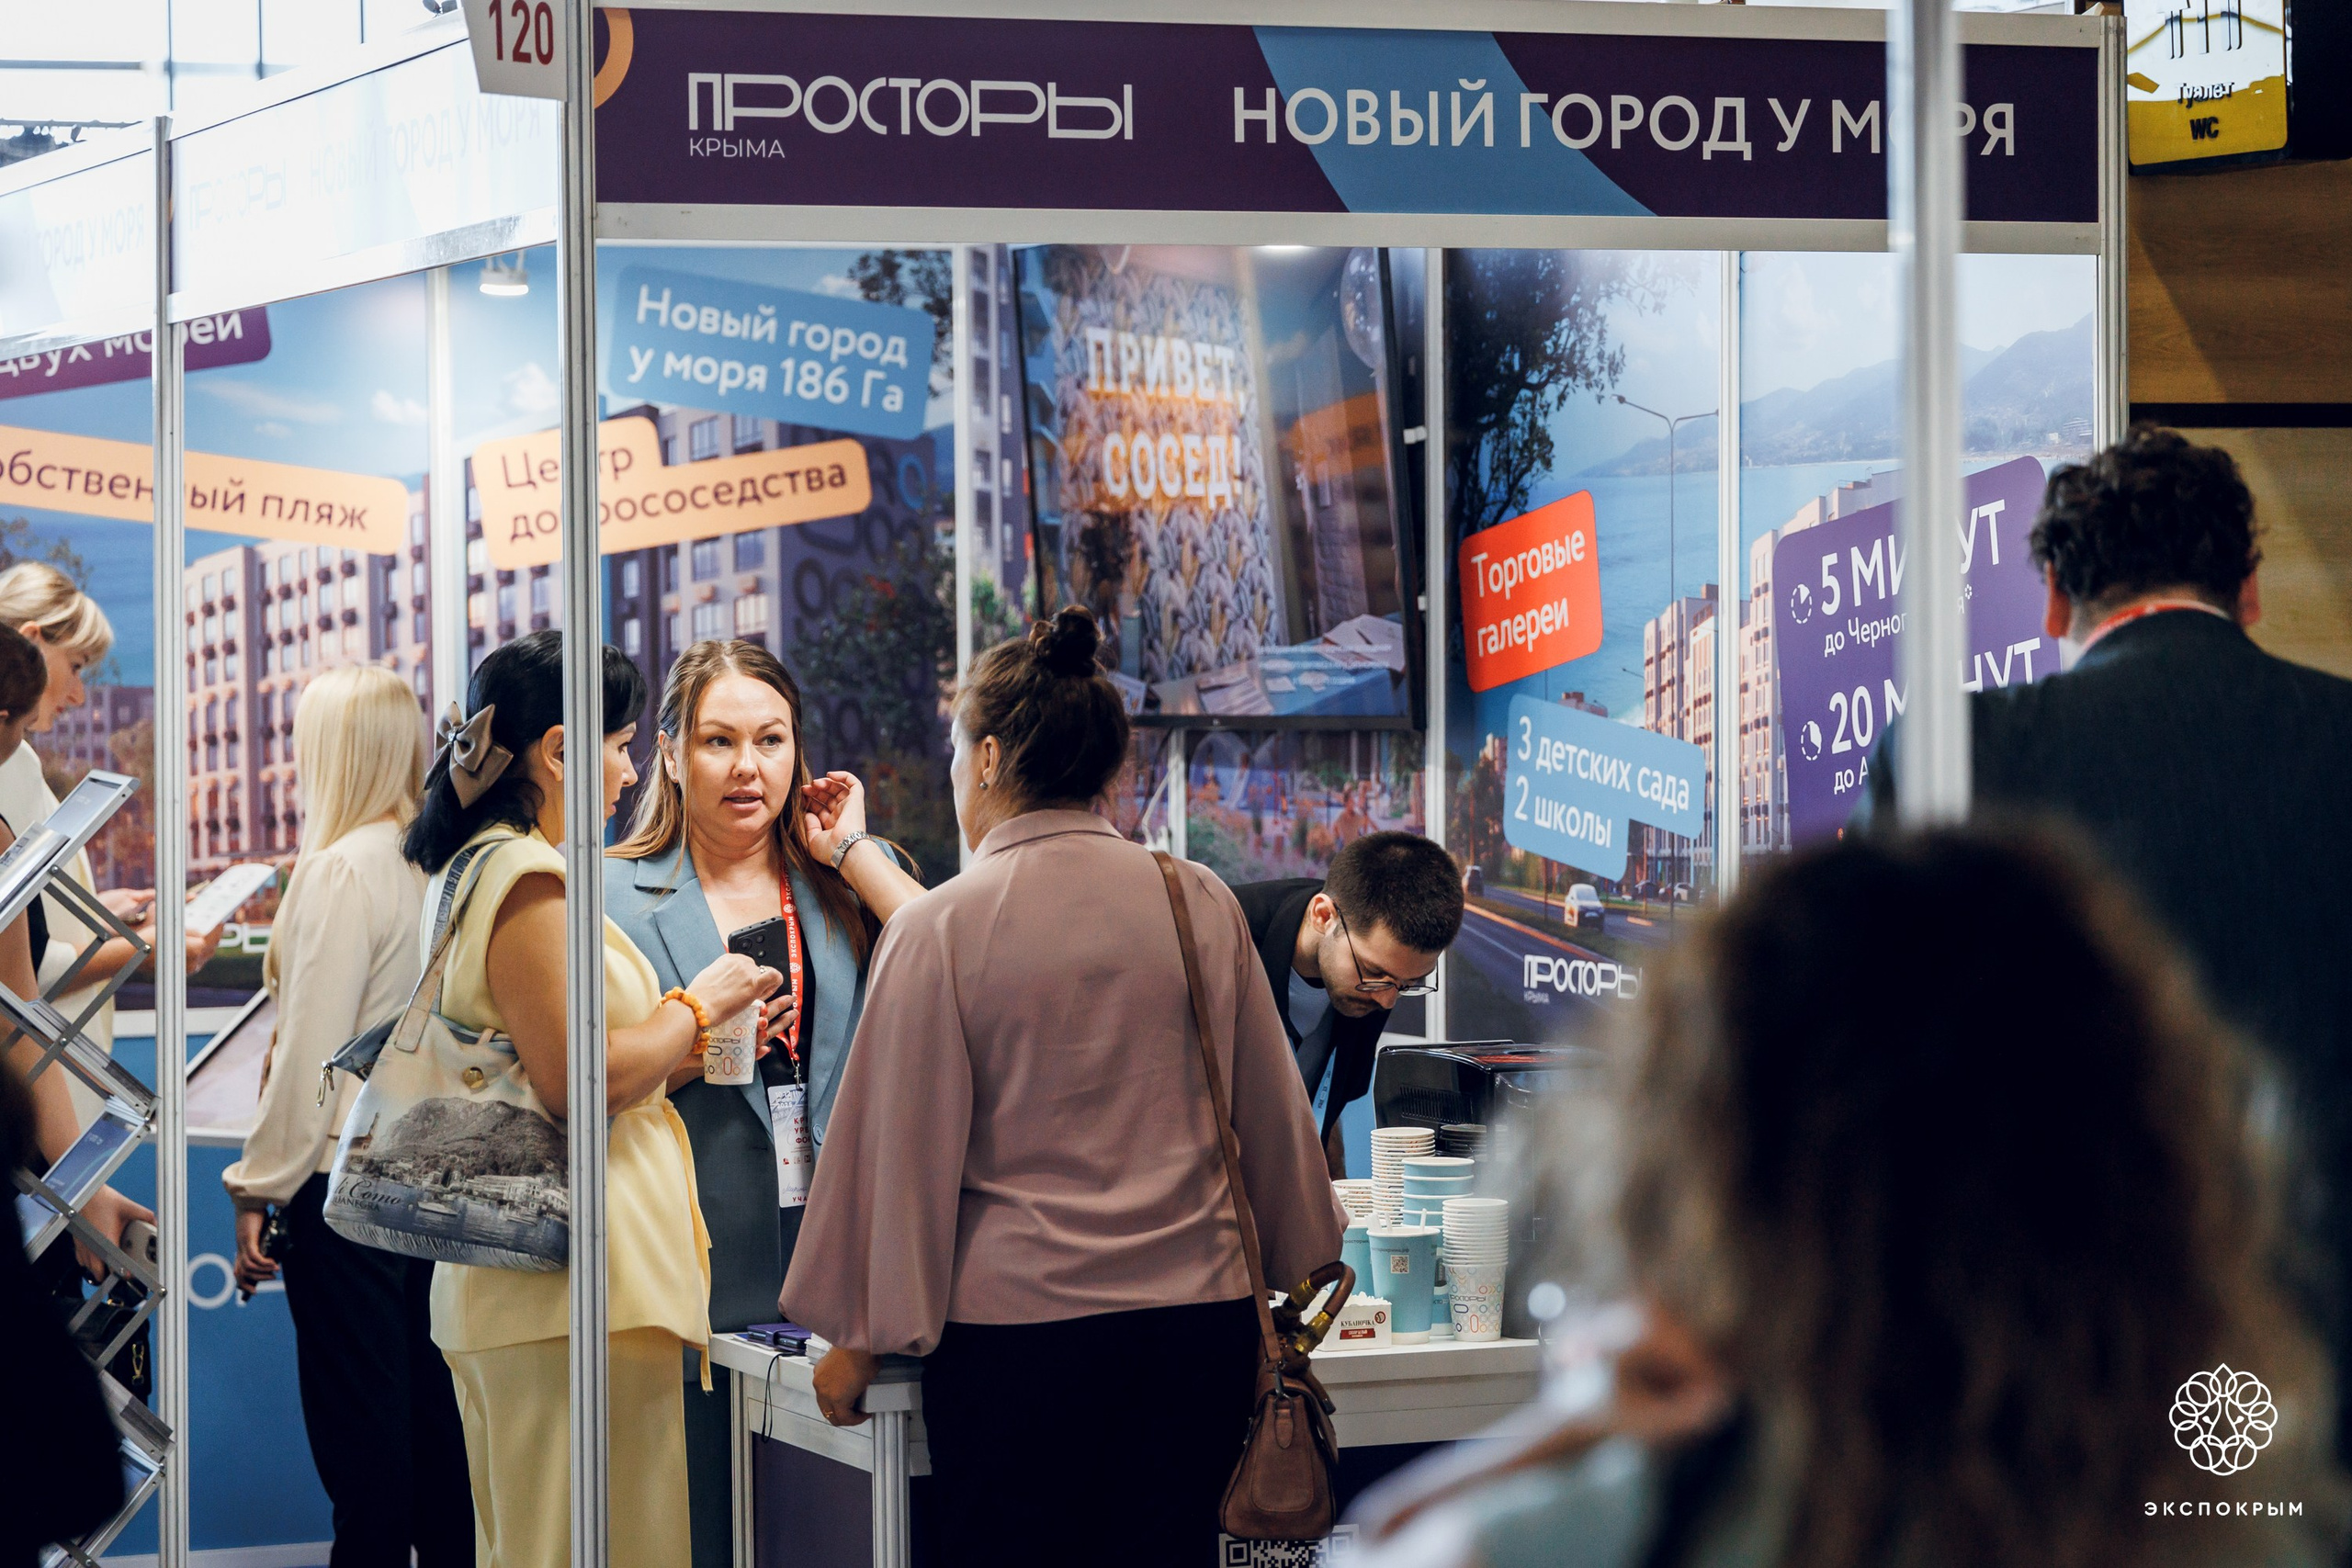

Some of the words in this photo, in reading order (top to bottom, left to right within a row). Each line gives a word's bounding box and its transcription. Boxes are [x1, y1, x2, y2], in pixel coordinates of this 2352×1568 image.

[488, 0, 553, 65] 120
[687, 73, 1133, 140] ПРОСТОРЫ
[1233, 78, 1495, 148] НОВЫЙ
[1520, 93, 1752, 161] ГОРОД
[1768, 98, 1812, 152] У
[1832, 99, 2015, 156] МРЯ
[2175, 82, 2235, 109] Туалет
[2189, 116, 2220, 141] WC
[689, 138, 786, 159] КРЫМА
[105, 310, 243, 358] моей
[636, 284, 778, 344] Новый
[787, 320, 909, 369] город
[627, 344, 655, 384] у
[662, 350, 769, 397] моря
[779, 356, 850, 405] 186
[861, 368, 905, 413] Га
[0, 449, 244, 514] бственый
[261, 493, 368, 531] пляж
[502, 446, 633, 491] Цетр
[510, 461, 848, 543] доососедства
[1103, 431, 1243, 510] СОСЕД!
[1470, 529, 1586, 601] Торговые
[1821, 552, 1841, 615] 5
[1850, 499, 2006, 607] МИУТ
[1476, 597, 1569, 657] галереи
[1824, 631, 1845, 658] до
[1828, 685, 1873, 754] 20
[1883, 637, 2041, 727] МНУТ
[1517, 716, 1532, 761] 3
[1535, 736, 1632, 793] детских
[1636, 766, 1690, 814] сада
[1834, 768, 1854, 795] до
[1514, 775, 1529, 821] 2
[1534, 795, 1612, 848] школы
[788, 916, 797, 958] ЭКСПОКРЫМ
[1523, 954, 1643, 999] ПРОСТОРЫ
